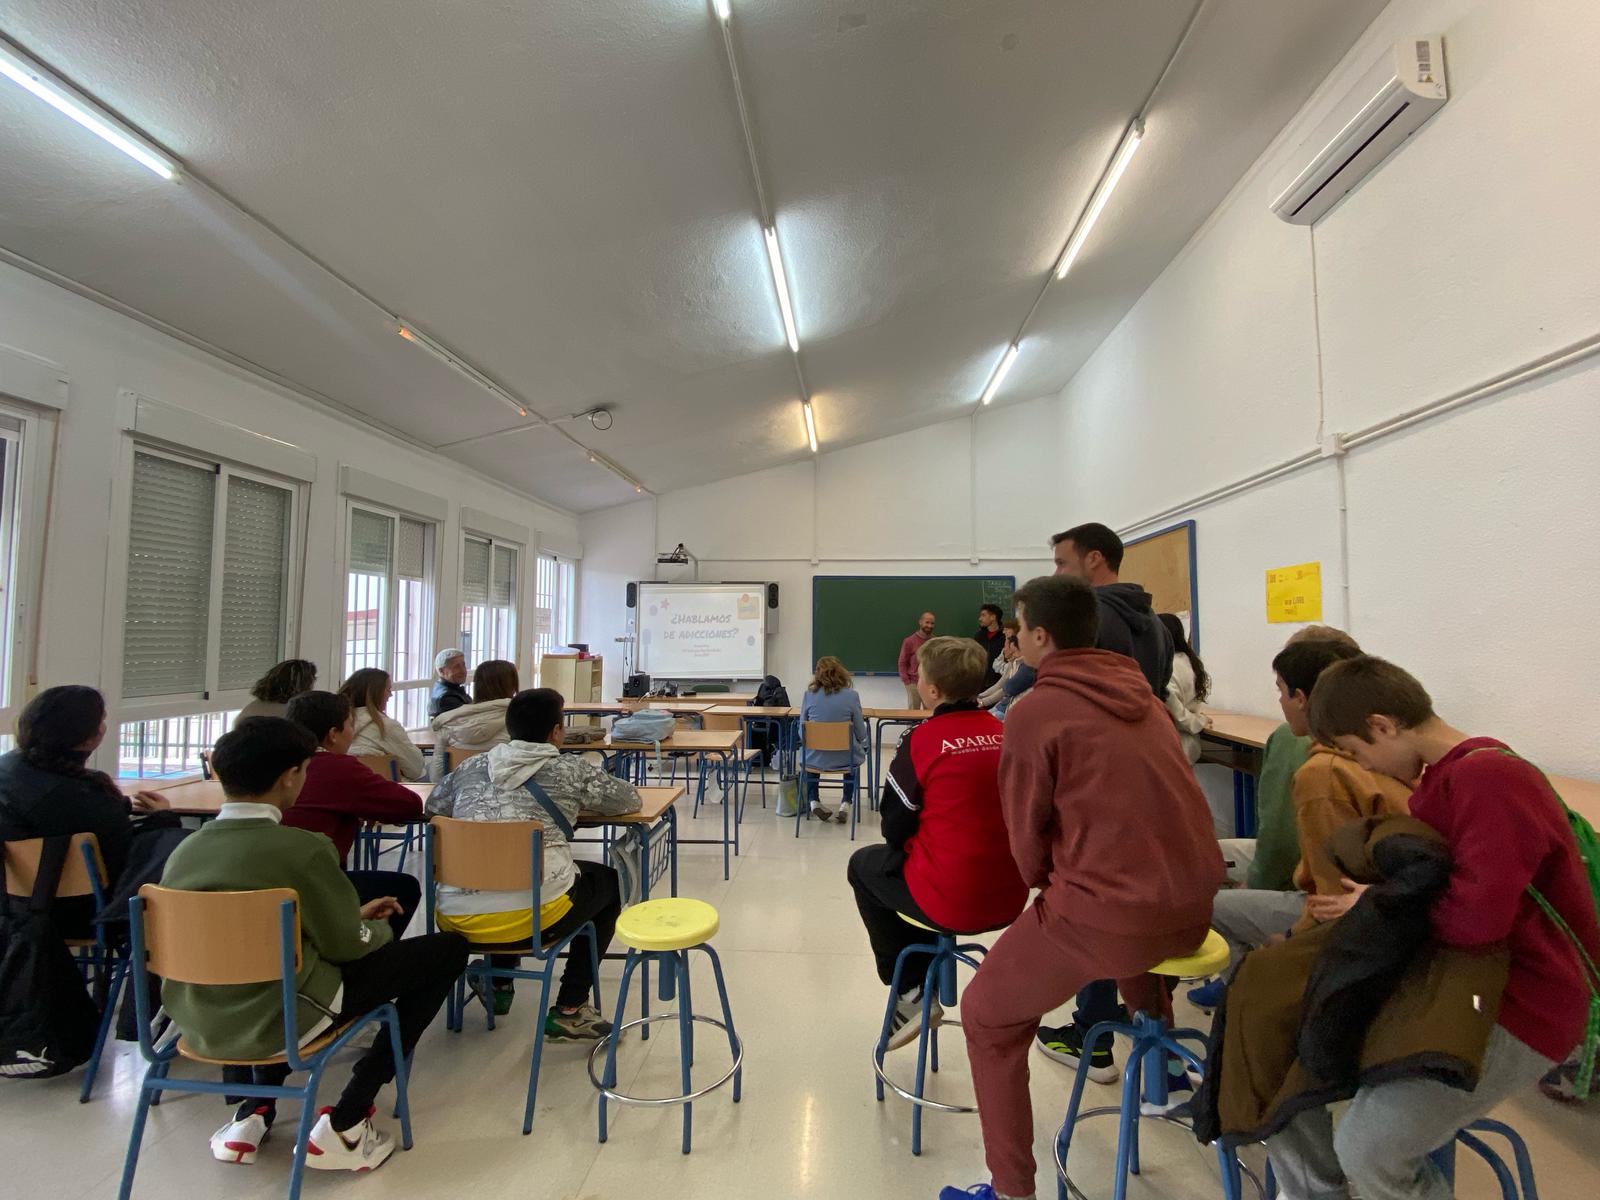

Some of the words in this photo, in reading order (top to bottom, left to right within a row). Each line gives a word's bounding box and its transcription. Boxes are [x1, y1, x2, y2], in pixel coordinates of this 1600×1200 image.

[671, 614, 732, 624] ¿HABLAMOS
[664, 630, 675, 640] DE
[679, 628, 739, 640] ADICCIONES?
[940, 734, 1004, 753] APARIC
